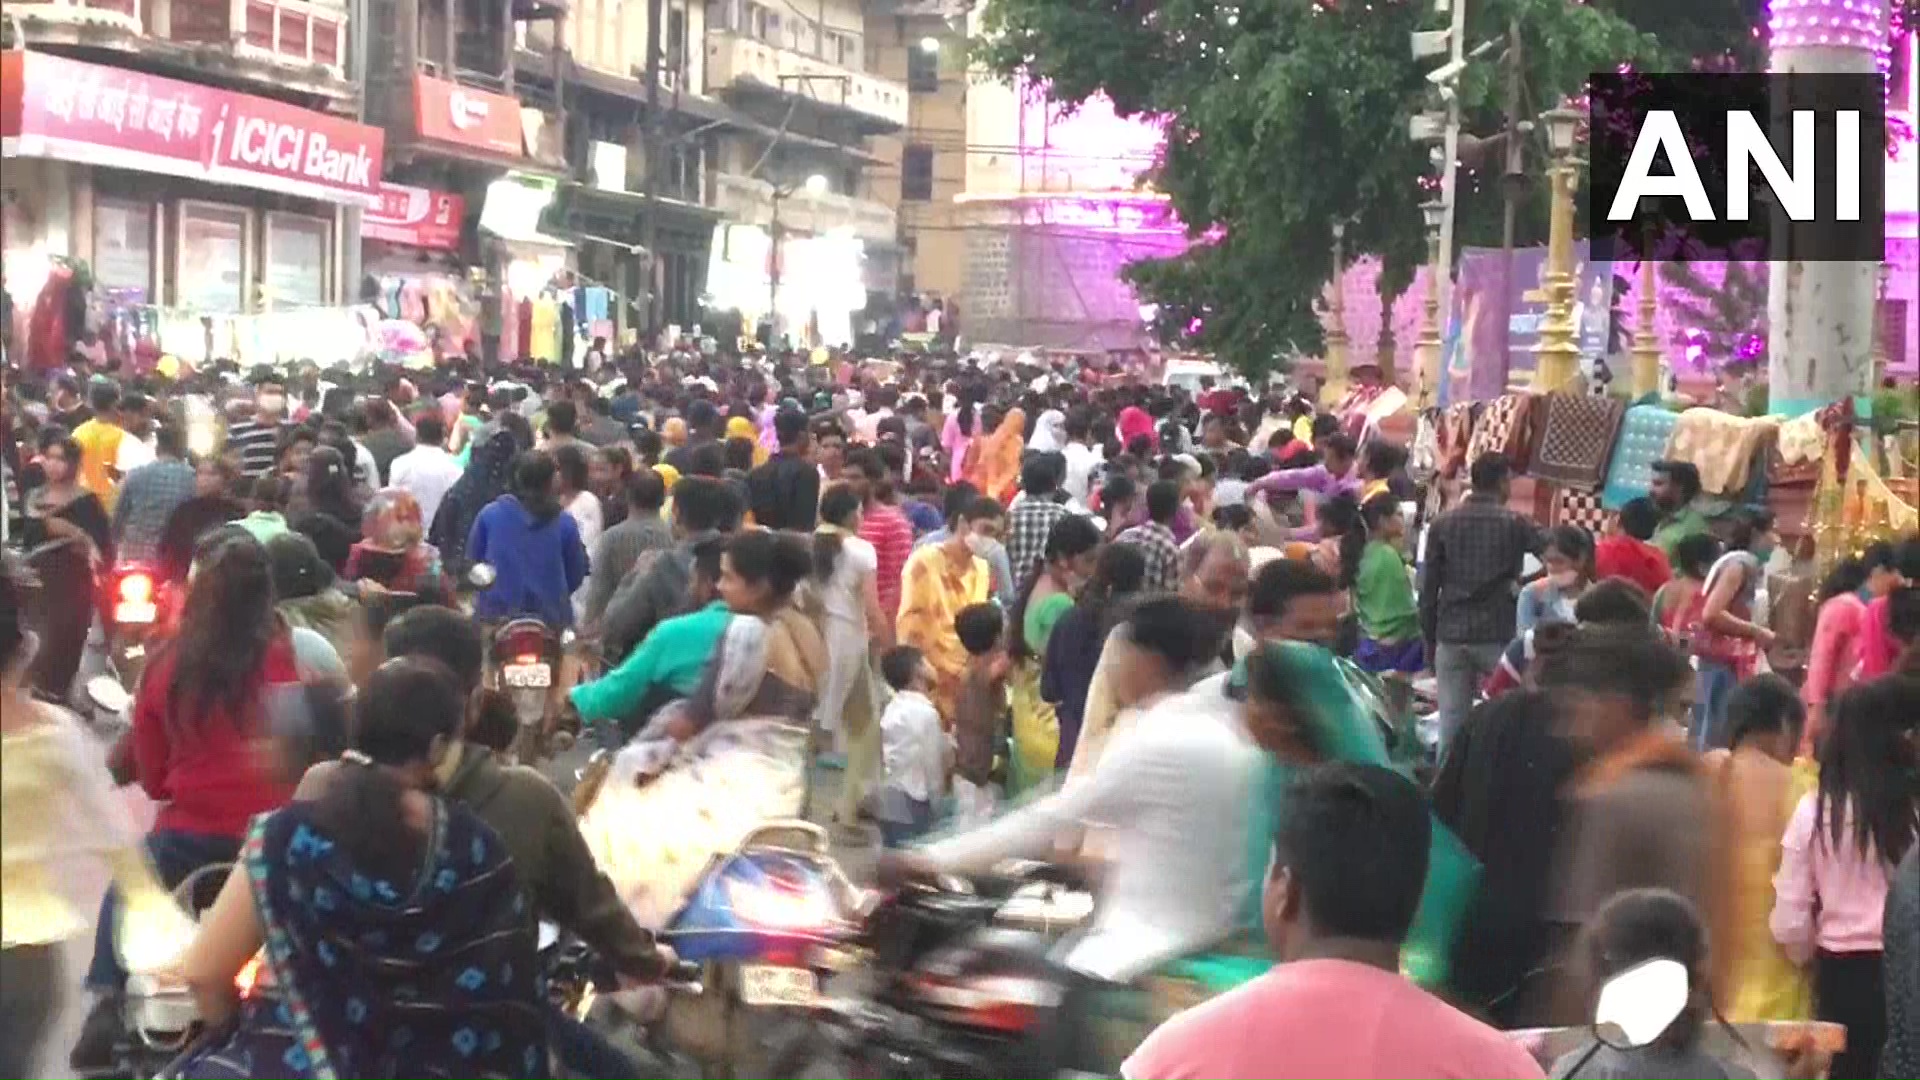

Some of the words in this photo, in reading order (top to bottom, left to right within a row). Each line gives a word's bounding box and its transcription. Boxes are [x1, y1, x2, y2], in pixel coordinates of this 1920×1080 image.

[97, 78, 130, 133] आई
[129, 81, 150, 130] सी
[147, 90, 178, 142] आई
[230, 115, 305, 172] ICICI
[304, 132, 373, 187] Bank
